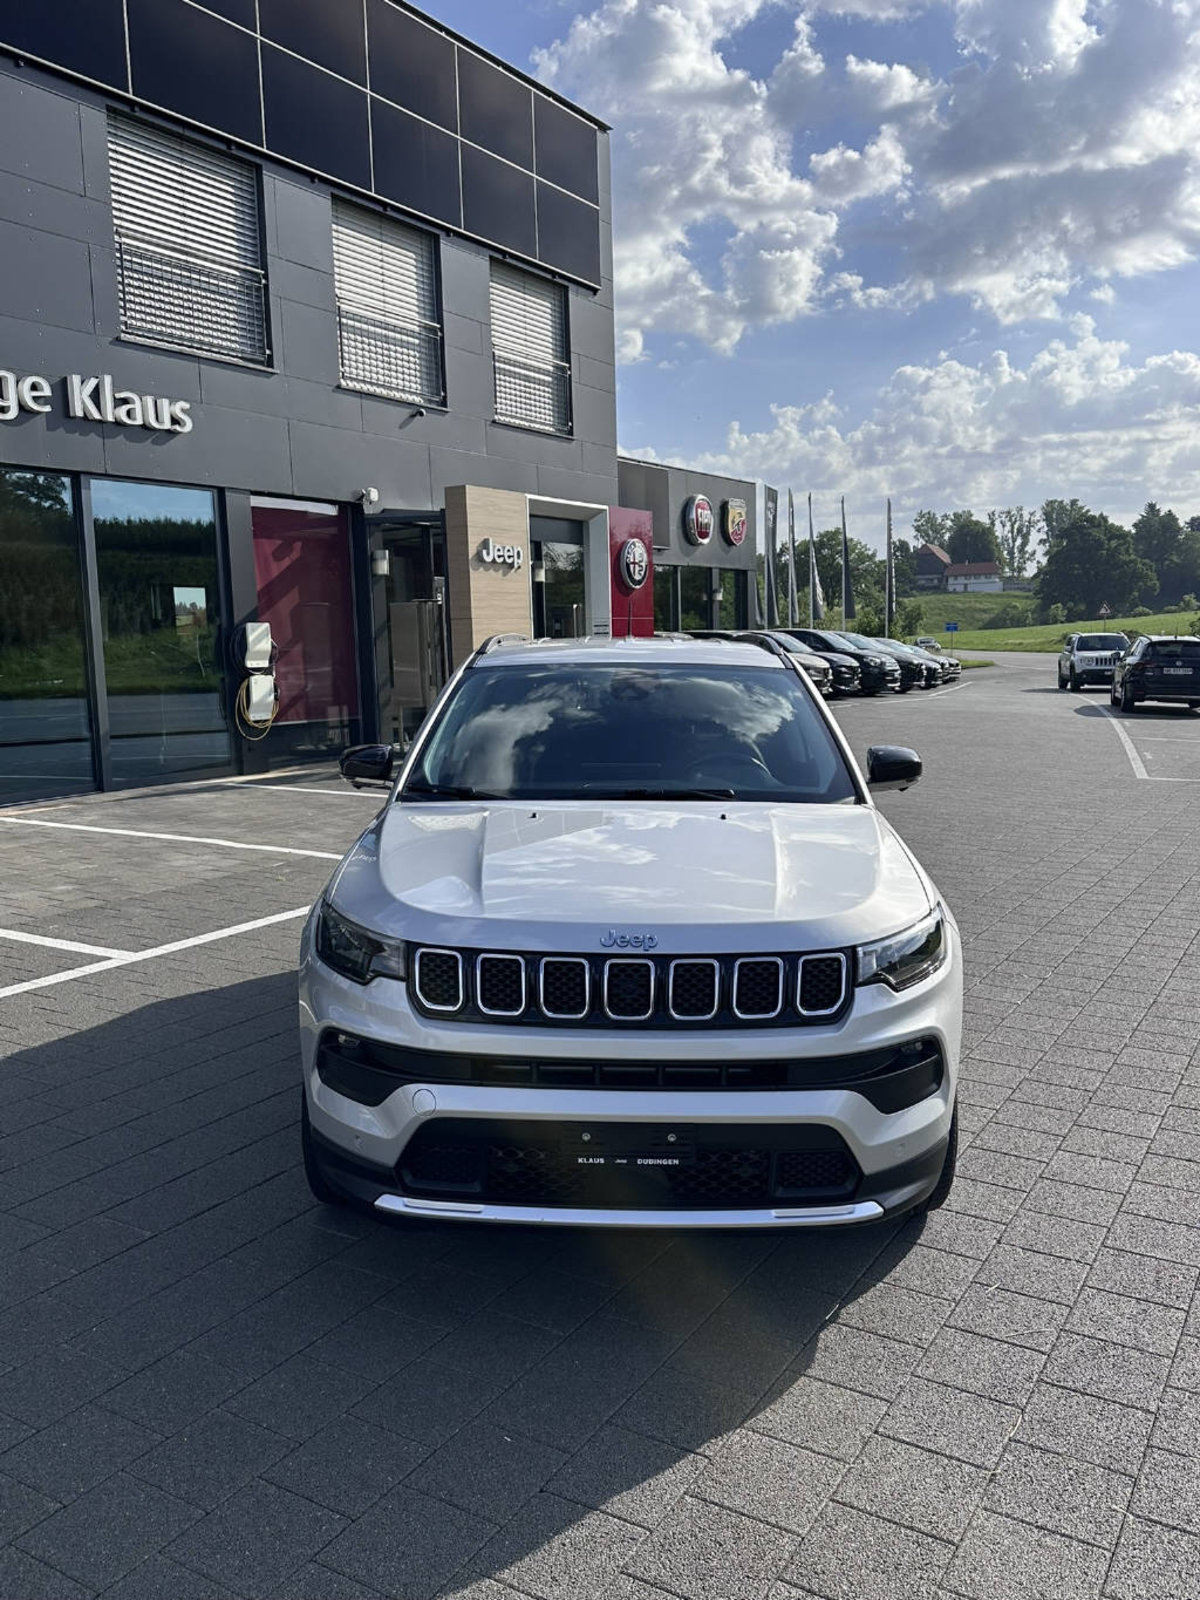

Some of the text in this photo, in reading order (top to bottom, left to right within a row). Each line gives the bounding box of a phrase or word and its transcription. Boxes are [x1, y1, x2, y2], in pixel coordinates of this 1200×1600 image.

[66, 374, 193, 433] Klaus
[697, 508, 712, 532] FIAT
[482, 537, 523, 569] Jeep
[600, 929, 658, 951] Jeep
